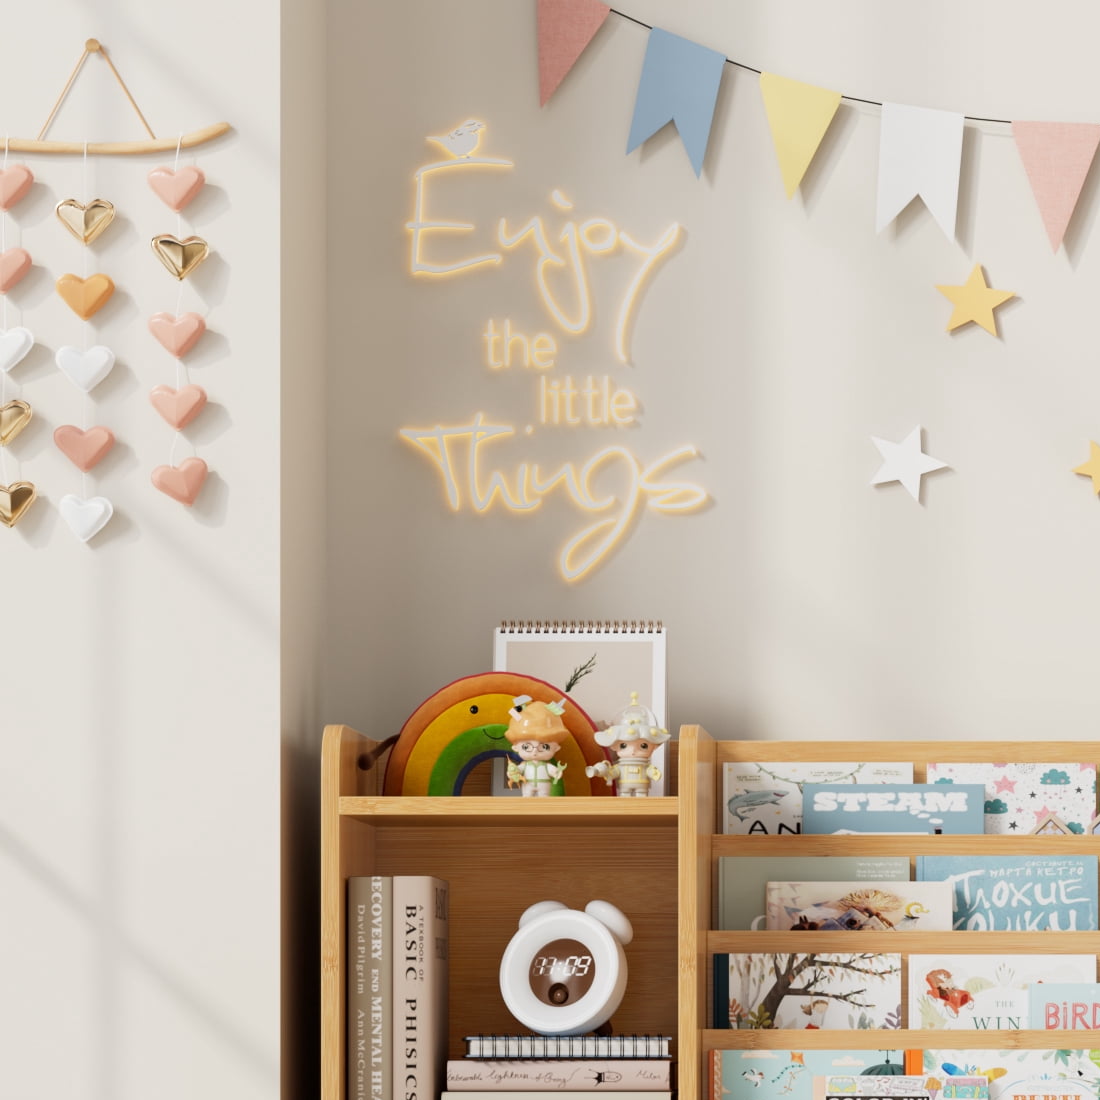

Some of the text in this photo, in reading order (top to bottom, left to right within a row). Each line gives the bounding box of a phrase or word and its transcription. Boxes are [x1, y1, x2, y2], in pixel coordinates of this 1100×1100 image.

[405, 157, 681, 362] Enjoy
[483, 318, 557, 369] the
[539, 375, 638, 425] little
[399, 411, 708, 580] Things
[812, 791, 969, 813] STEAM
[357, 904, 366, 943] David
[418, 904, 425, 912] A
[405, 904, 417, 981] BASIC
[355, 946, 366, 994] Pilgrim
[371, 969, 379, 992] END
[418, 968, 425, 982] OF
[357, 1009, 366, 1036] Ann
[972, 1016, 1022, 1030] WIN
[994, 1000, 1015, 1008] THE
[371, 996, 383, 1068] MENTAL
